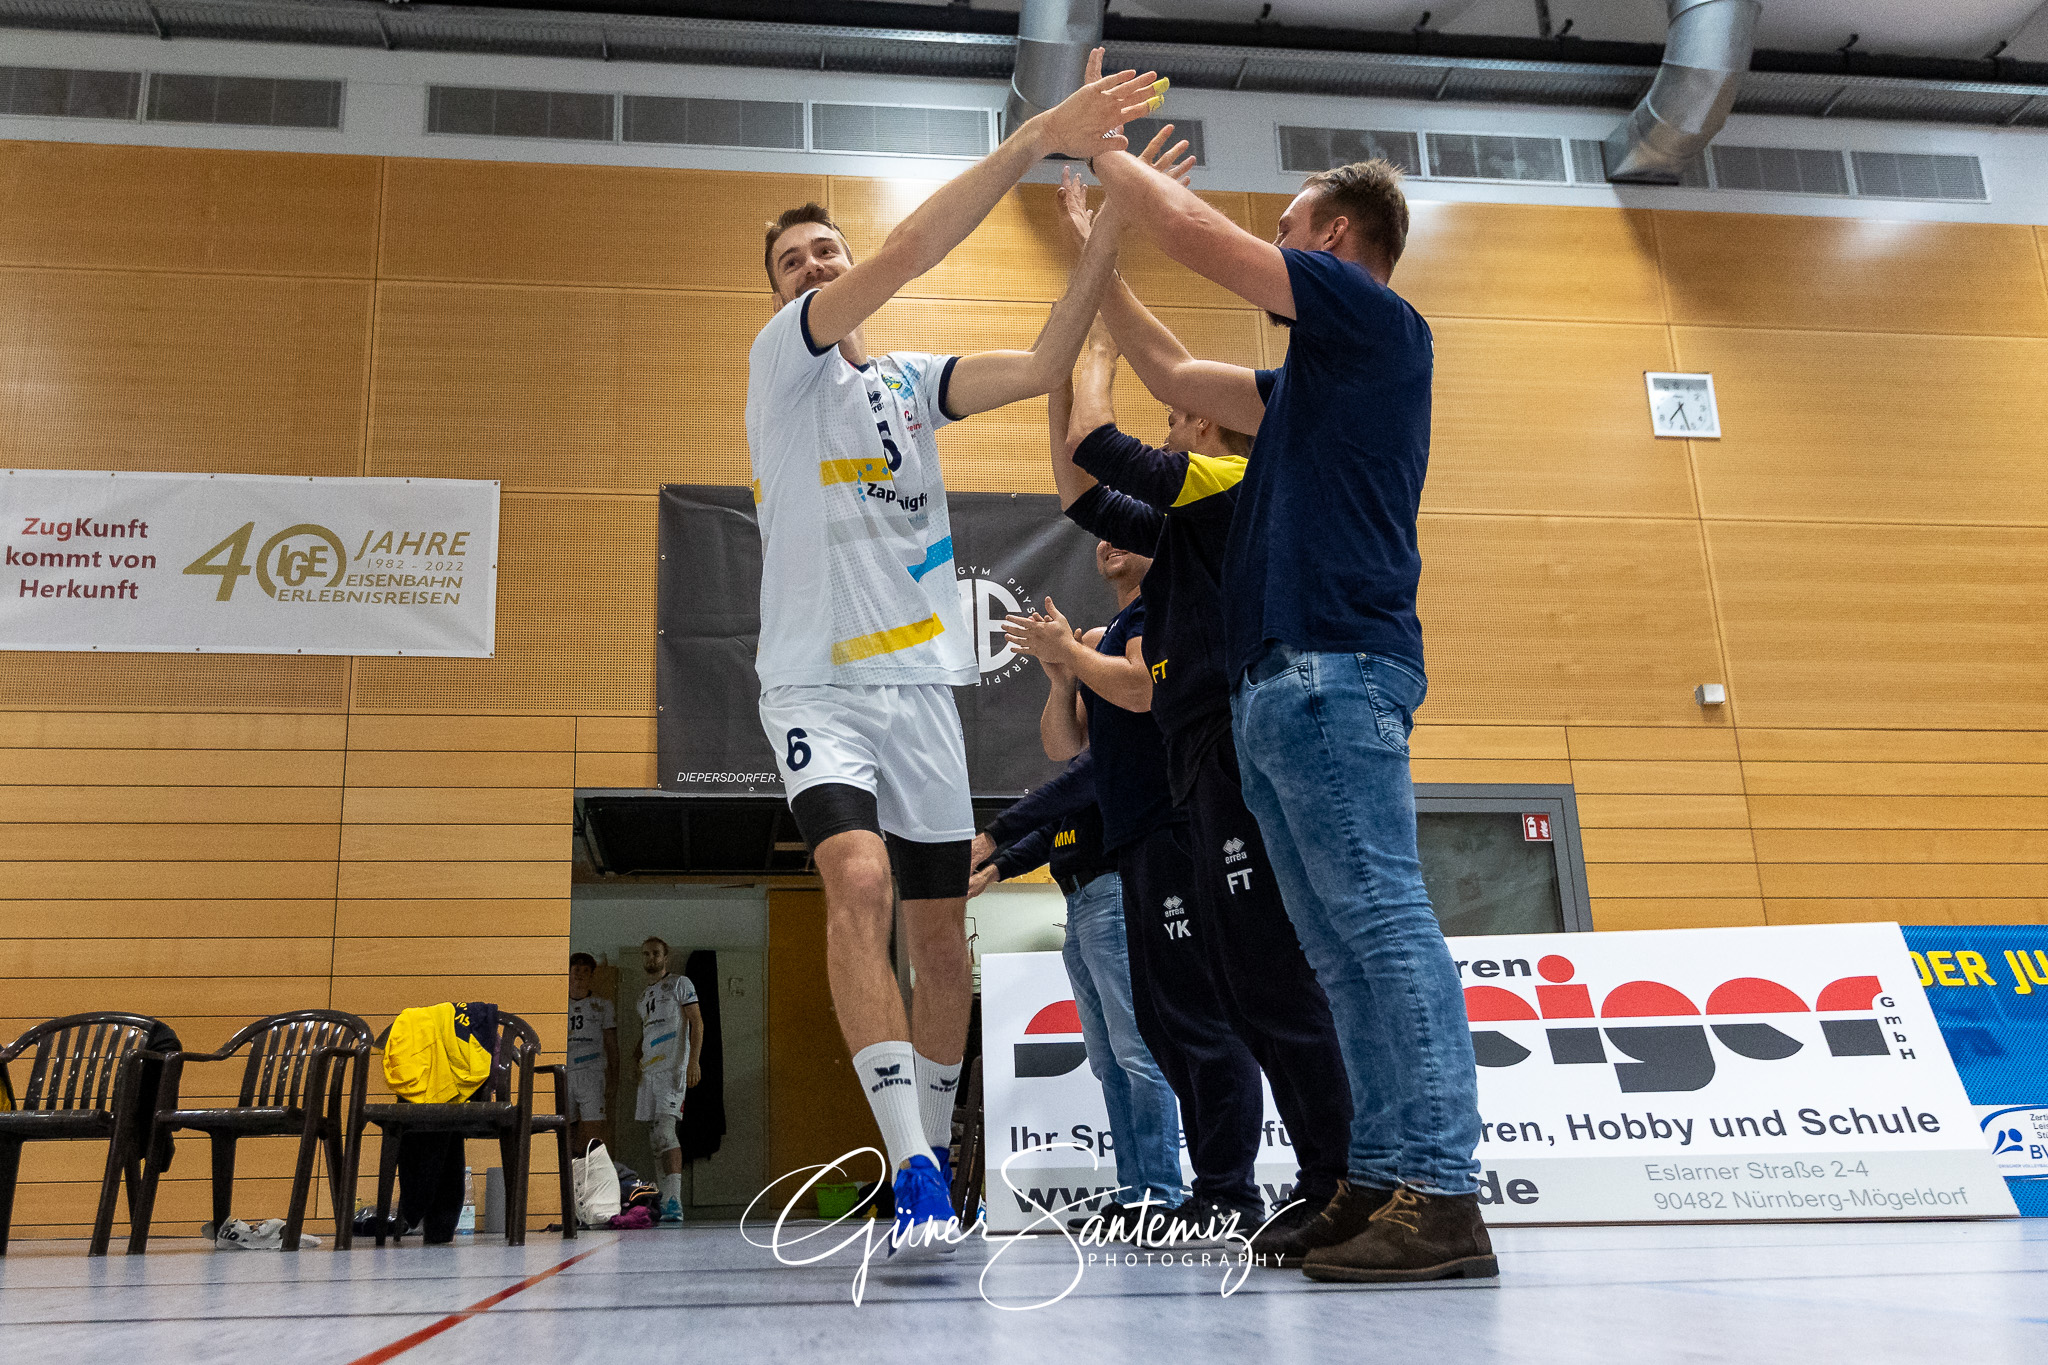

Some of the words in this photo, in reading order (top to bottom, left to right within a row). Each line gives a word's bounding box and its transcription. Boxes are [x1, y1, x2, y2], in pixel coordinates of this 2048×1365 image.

[21, 517, 149, 542] ZugKunft
[5, 545, 102, 568] kommt
[109, 554, 157, 569] von
[353, 530, 471, 562] JAHRE
[276, 544, 328, 587] IGE
[367, 558, 404, 569] 1982
[425, 561, 464, 572] 2022
[19, 578, 138, 600] Herkunft
[346, 573, 463, 588] EISENBAHN
[277, 589, 461, 606] ERLEBNISREISEN
[786, 727, 812, 772] 6
[677, 772, 776, 783] DIEPERSDORFER
[1226, 867, 1253, 895] FT
[1163, 919, 1192, 940] YK
[570, 1015, 584, 1030] 13
[1565, 1112, 1694, 1146] Hobby
[1709, 1109, 1788, 1138] und
[1797, 1106, 1941, 1136] Schule
[1010, 1126, 1059, 1153] Ihr
[1644, 1162, 1740, 1181] Eslarner
[1747, 1161, 1826, 1180] Straße
[1830, 1159, 1870, 1178] 2-4
[1653, 1191, 1728, 1210] 90482
[1732, 1186, 1969, 1212] Nürnberg-Mögeldorf
